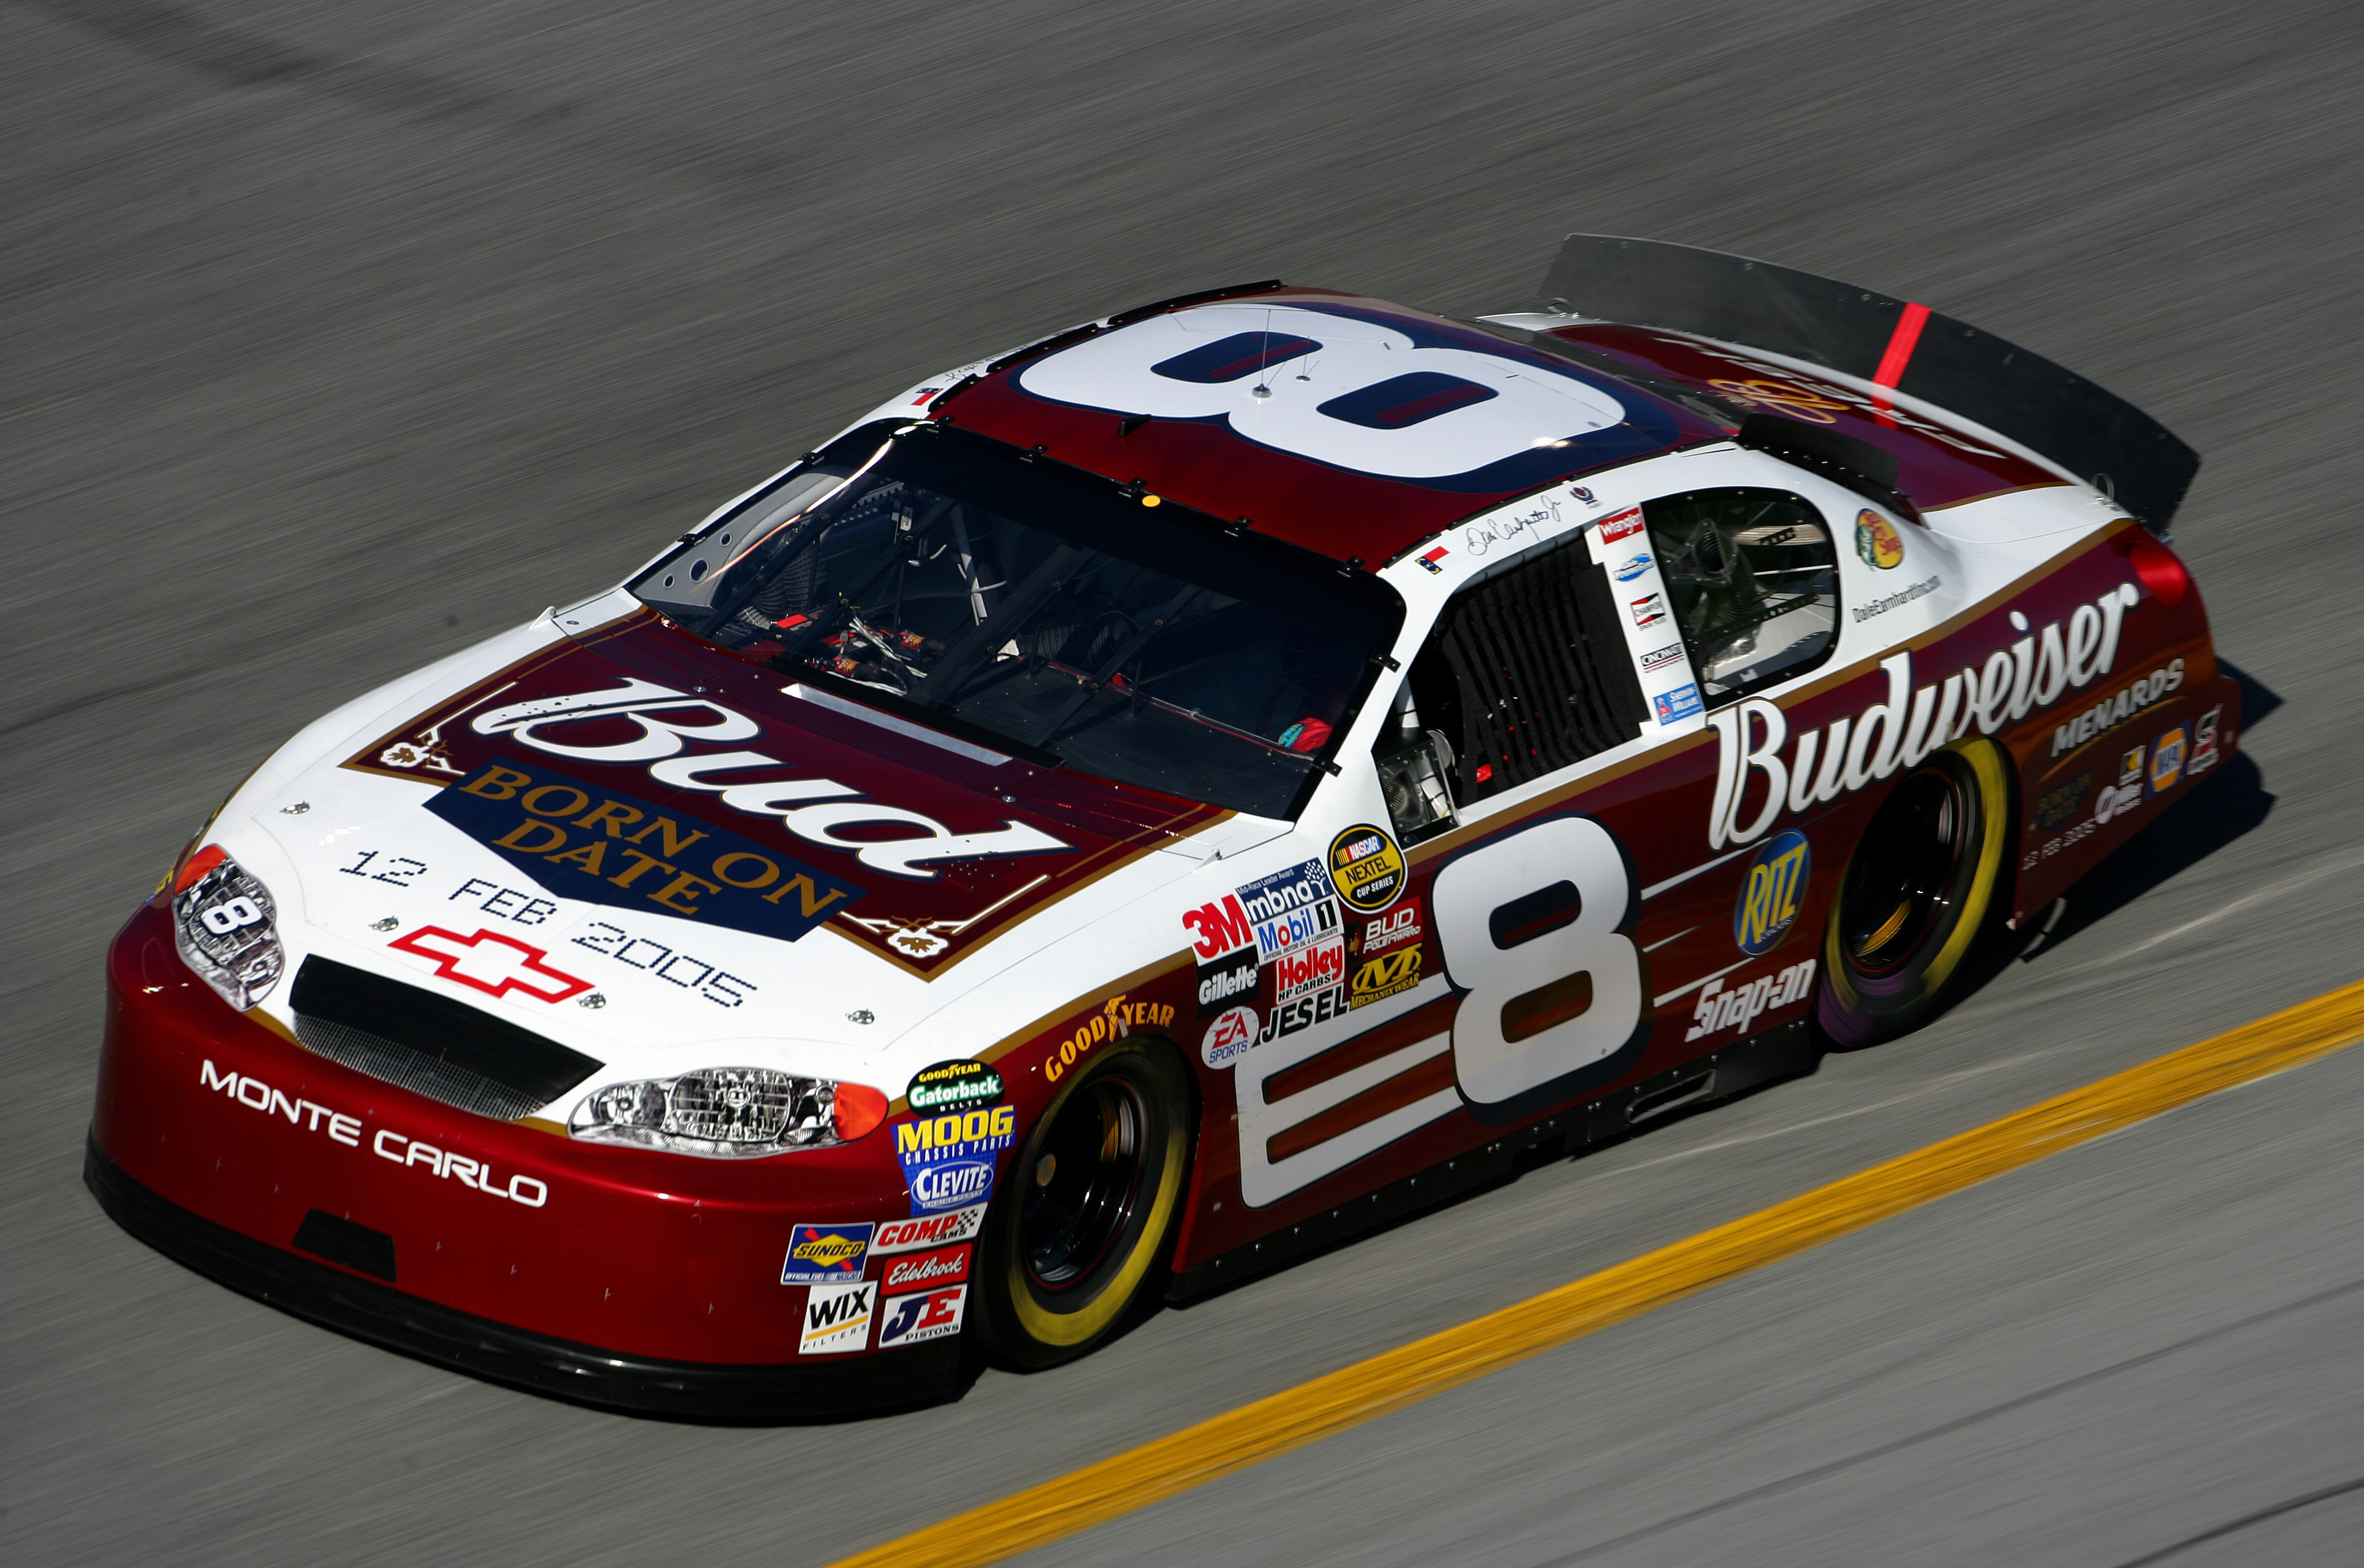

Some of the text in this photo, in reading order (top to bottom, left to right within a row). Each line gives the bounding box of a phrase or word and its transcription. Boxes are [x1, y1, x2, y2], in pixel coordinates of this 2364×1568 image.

[1020, 303, 1626, 478] 8
[1707, 581, 2140, 851] Budweiser
[2050, 658, 2185, 758] MENARDS
[472, 677, 1074, 878] Bud
[459, 765, 848, 918] BORN ON
[1349, 835, 1380, 860] NASCAR
[491, 817, 723, 915] DATE
[1344, 856, 1391, 885] NEXTEL
[1246, 879, 1314, 922] mbna
[1357, 875, 1394, 899] CUP SERIES
[1737, 841, 1808, 946] RITZ
[201, 896, 263, 934] 8
[340, 849, 758, 1008] 12 FEB 2005
[1181, 894, 1254, 959] 3M
[1257, 908, 1315, 955] Mobil
[1365, 907, 1415, 941] BUD
[1277, 944, 1342, 991] Holley
[1433, 816, 1642, 1105] 8
[1199, 965, 1258, 1005] Gillette
[1278, 973, 1331, 1002] HP CARBS
[1350, 972, 1420, 1010] MECHANIX WEAR
[1684, 958, 1817, 1043] Snap-on
[1212, 1011, 1249, 1049] EA
[1261, 984, 1349, 1043] JESEL
[1209, 1040, 1248, 1063] SPORTS
[910, 1075, 1000, 1107] Gatorback
[939, 1099, 982, 1112] BELTS
[200, 1059, 548, 1208] MONTE CARLO
[897, 1105, 1015, 1154] MOOG
[905, 1135, 1011, 1166] CHASSIS PARTS
[916, 1164, 990, 1201] CLEVITE
[797, 1243, 863, 1256] SUNOCO
[877, 1214, 959, 1247] COMP
[930, 1227, 968, 1243] CAMS
[888, 1252, 965, 1286] Edelbrock
[809, 1284, 873, 1331] WIX
[881, 1288, 962, 1343] JE
[802, 1323, 867, 1351] FILTERS
[905, 1324, 959, 1341] PISTONS
